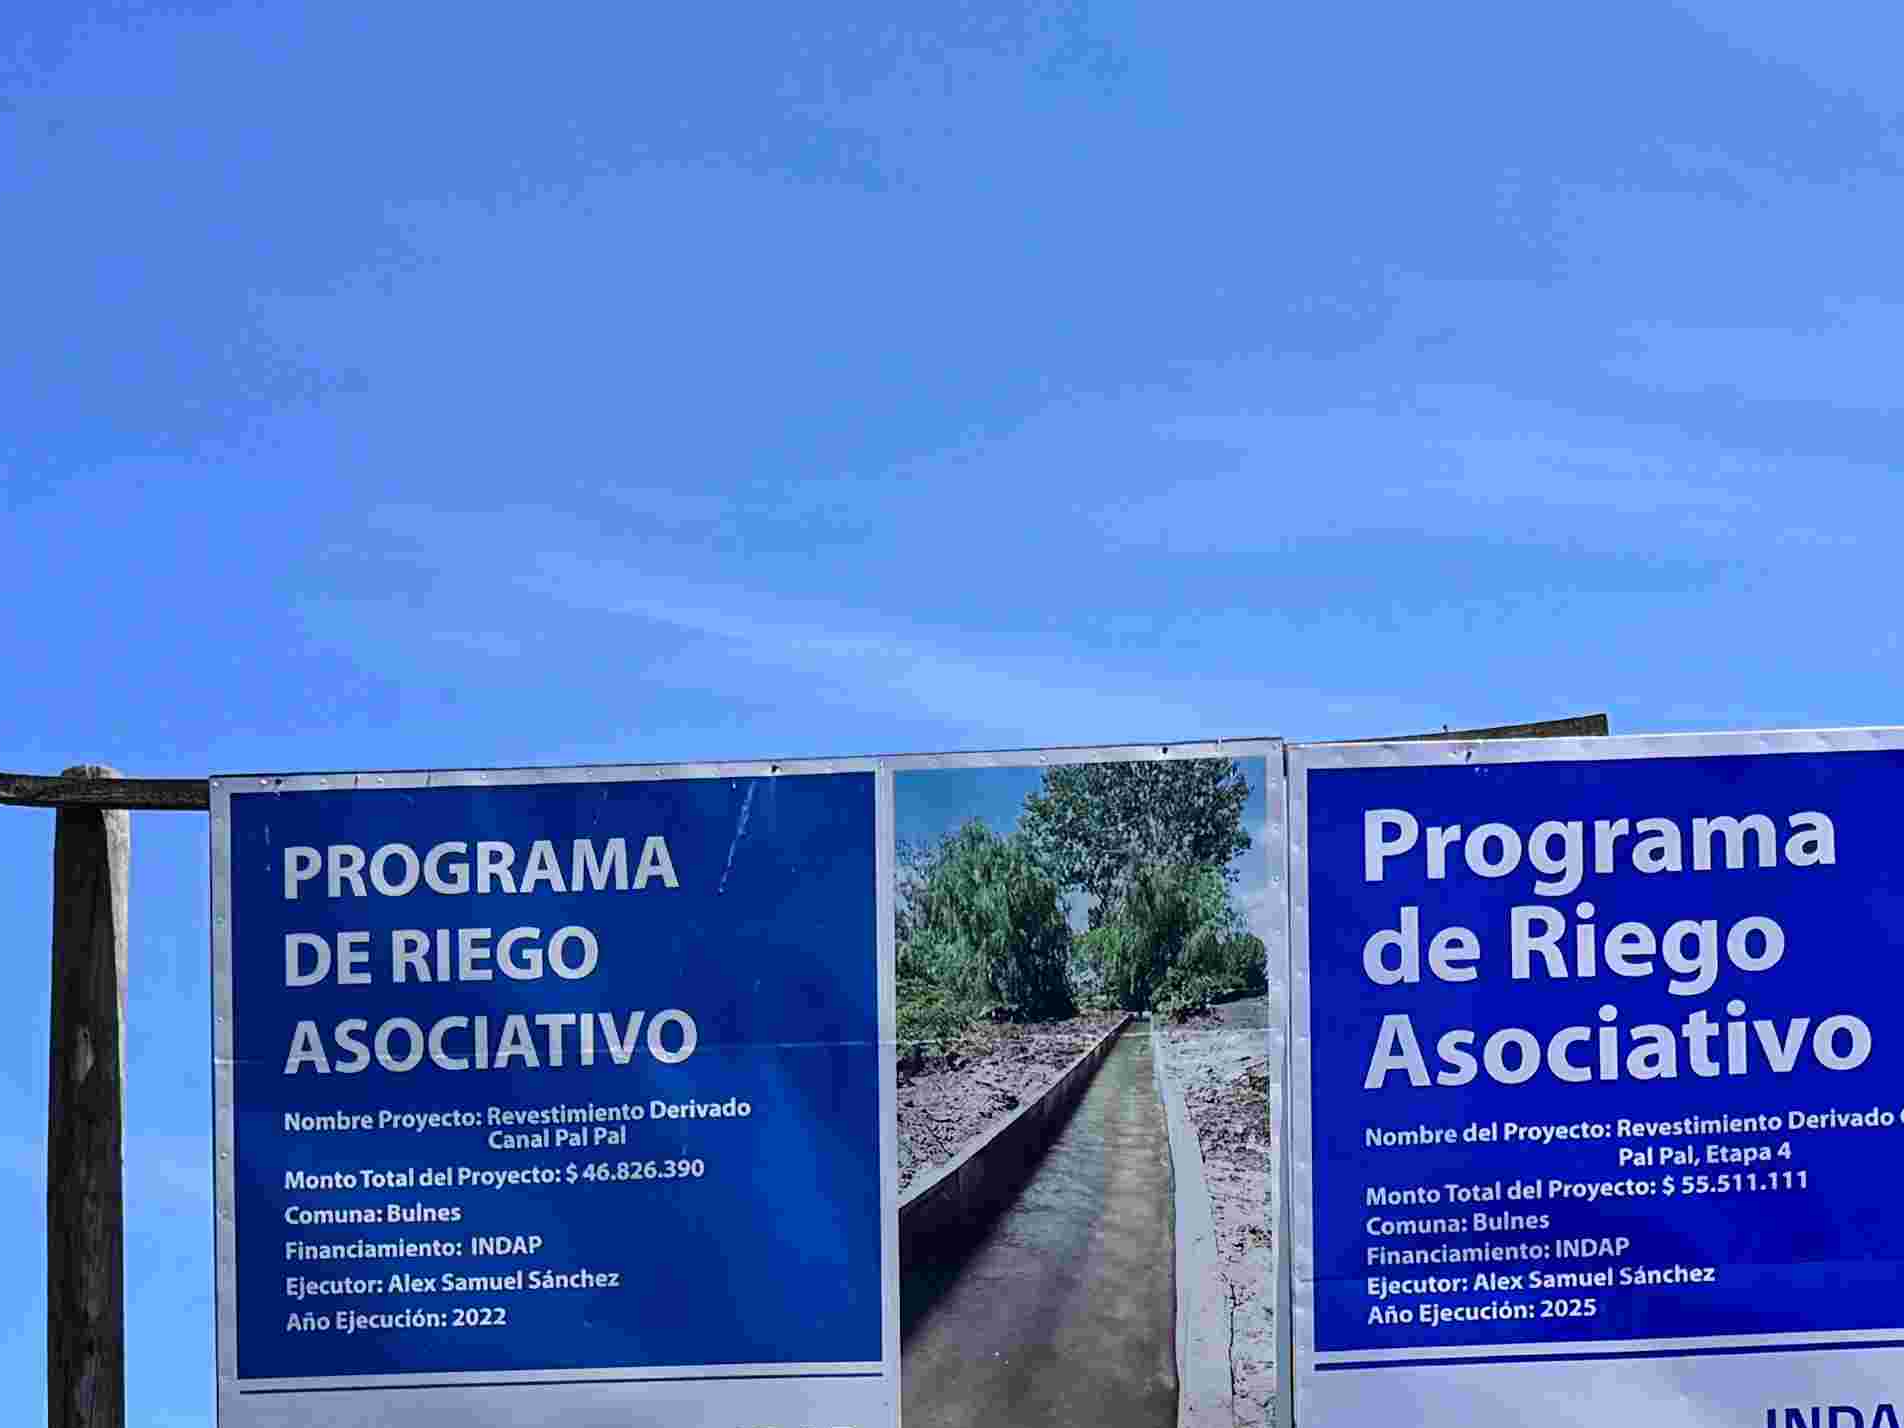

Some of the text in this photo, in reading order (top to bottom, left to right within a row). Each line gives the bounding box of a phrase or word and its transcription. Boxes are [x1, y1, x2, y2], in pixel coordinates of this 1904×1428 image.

[284, 835, 680, 899] PROGRAMA
[1364, 808, 1836, 897] Programa
[285, 925, 599, 987] DE RIEGO
[1362, 901, 1785, 996] de Riego
[283, 1008, 698, 1075] ASOCIATIVO
[1363, 999, 1872, 1089] Asociativo
[284, 1096, 752, 1133] Nombre Proyecto: Revestimiento Derivado
[1365, 1124, 1458, 1147] Nombre
[1462, 1121, 1498, 1143] del
[1503, 1121, 1611, 1145] Proyecto:
[1616, 1113, 1783, 1138] Revestimiento
[1788, 1106, 1895, 1130] Derivado
[487, 1124, 626, 1150] Canal Pal Pal
[1619, 1141, 1792, 1167] Pal Pal, Etapa 4
[284, 1158, 705, 1190] Monto Total del Proyecto: $ 46.826.390
[1366, 1170, 1807, 1206] Monto Total del Proyecto: $ 55.511.111
[284, 1202, 462, 1225] Comuna: Bulnes
[1366, 1210, 1550, 1236] Comuna: Bulnes
[285, 1235, 543, 1260] Financiamiento: INDAP
[1367, 1236, 1630, 1266] Financiamiento: INDAP
[286, 1268, 620, 1301] Ejecutor: Alex Samuel Sánchez
[1367, 1263, 1716, 1300] Ejecutor: Alex Samuel Sánchez
[286, 1307, 507, 1335] Año Ejecución: 2022
[1367, 1298, 1597, 1327] Año Ejecución: 2025
